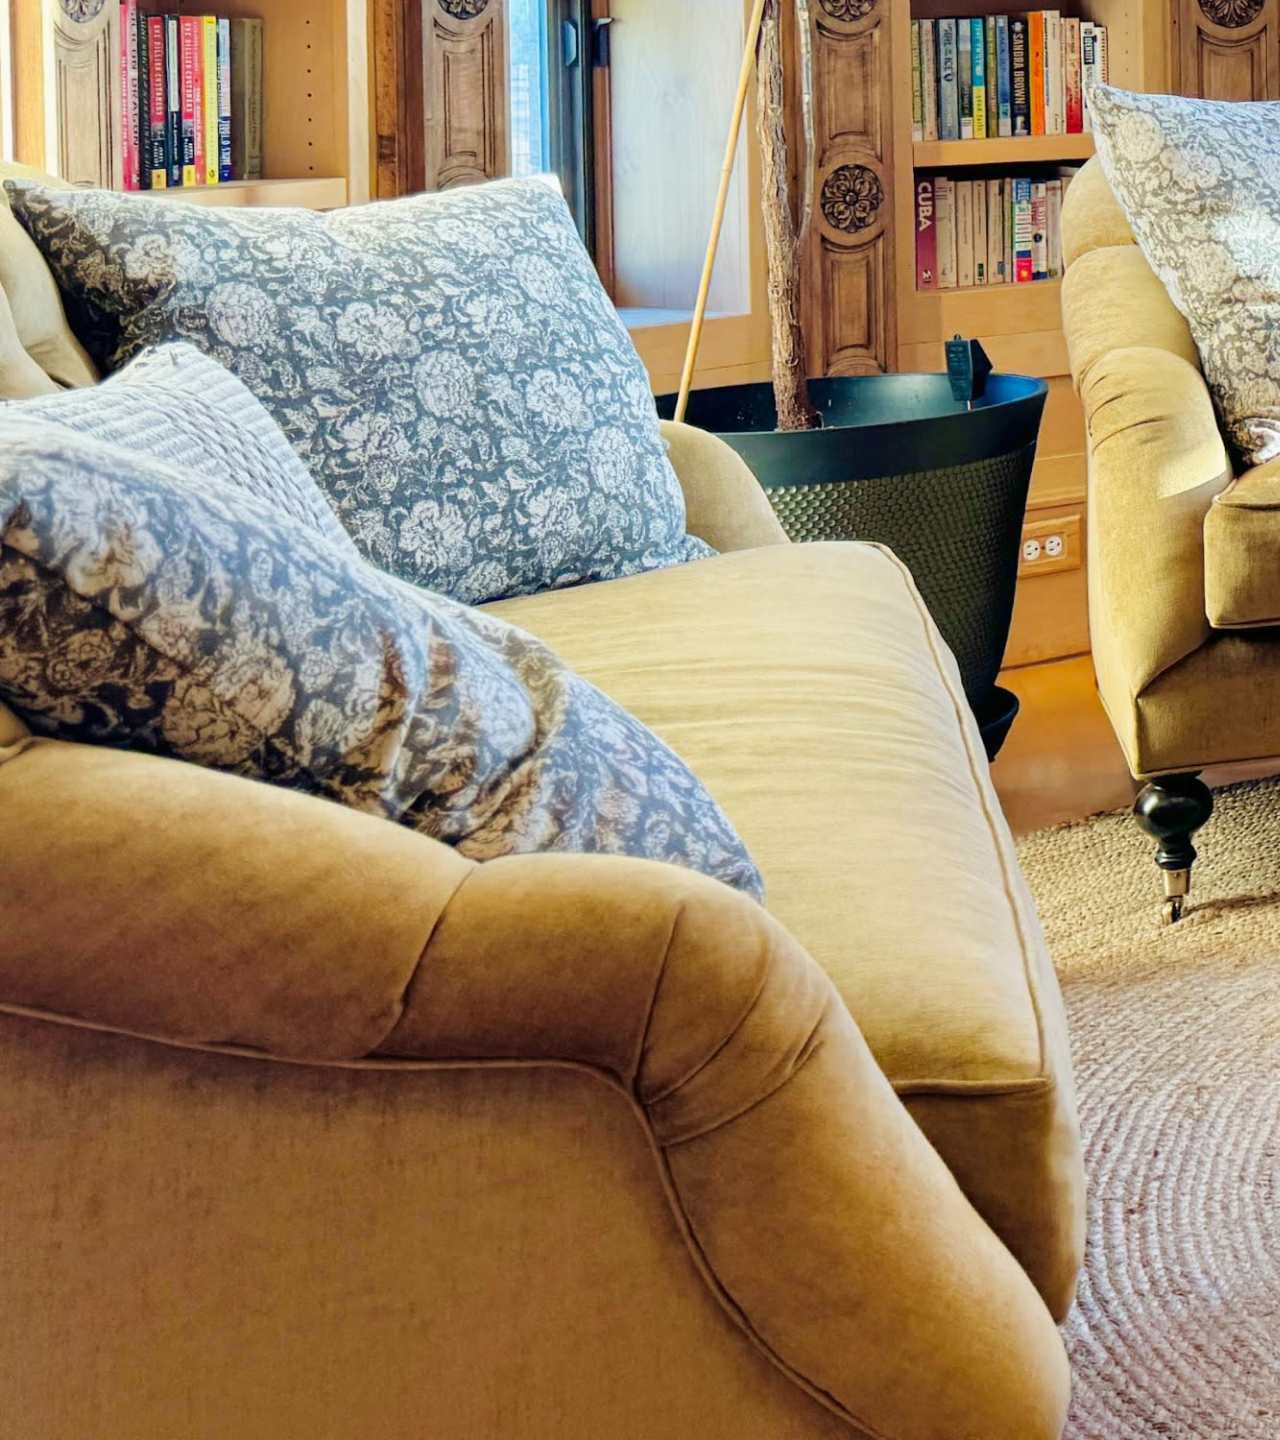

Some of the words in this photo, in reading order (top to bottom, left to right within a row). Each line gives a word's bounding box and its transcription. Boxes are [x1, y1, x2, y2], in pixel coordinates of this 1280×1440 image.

[1012, 33, 1026, 68] SANDRA
[1013, 71, 1026, 103] BROWN
[918, 182, 932, 231] CUBA
